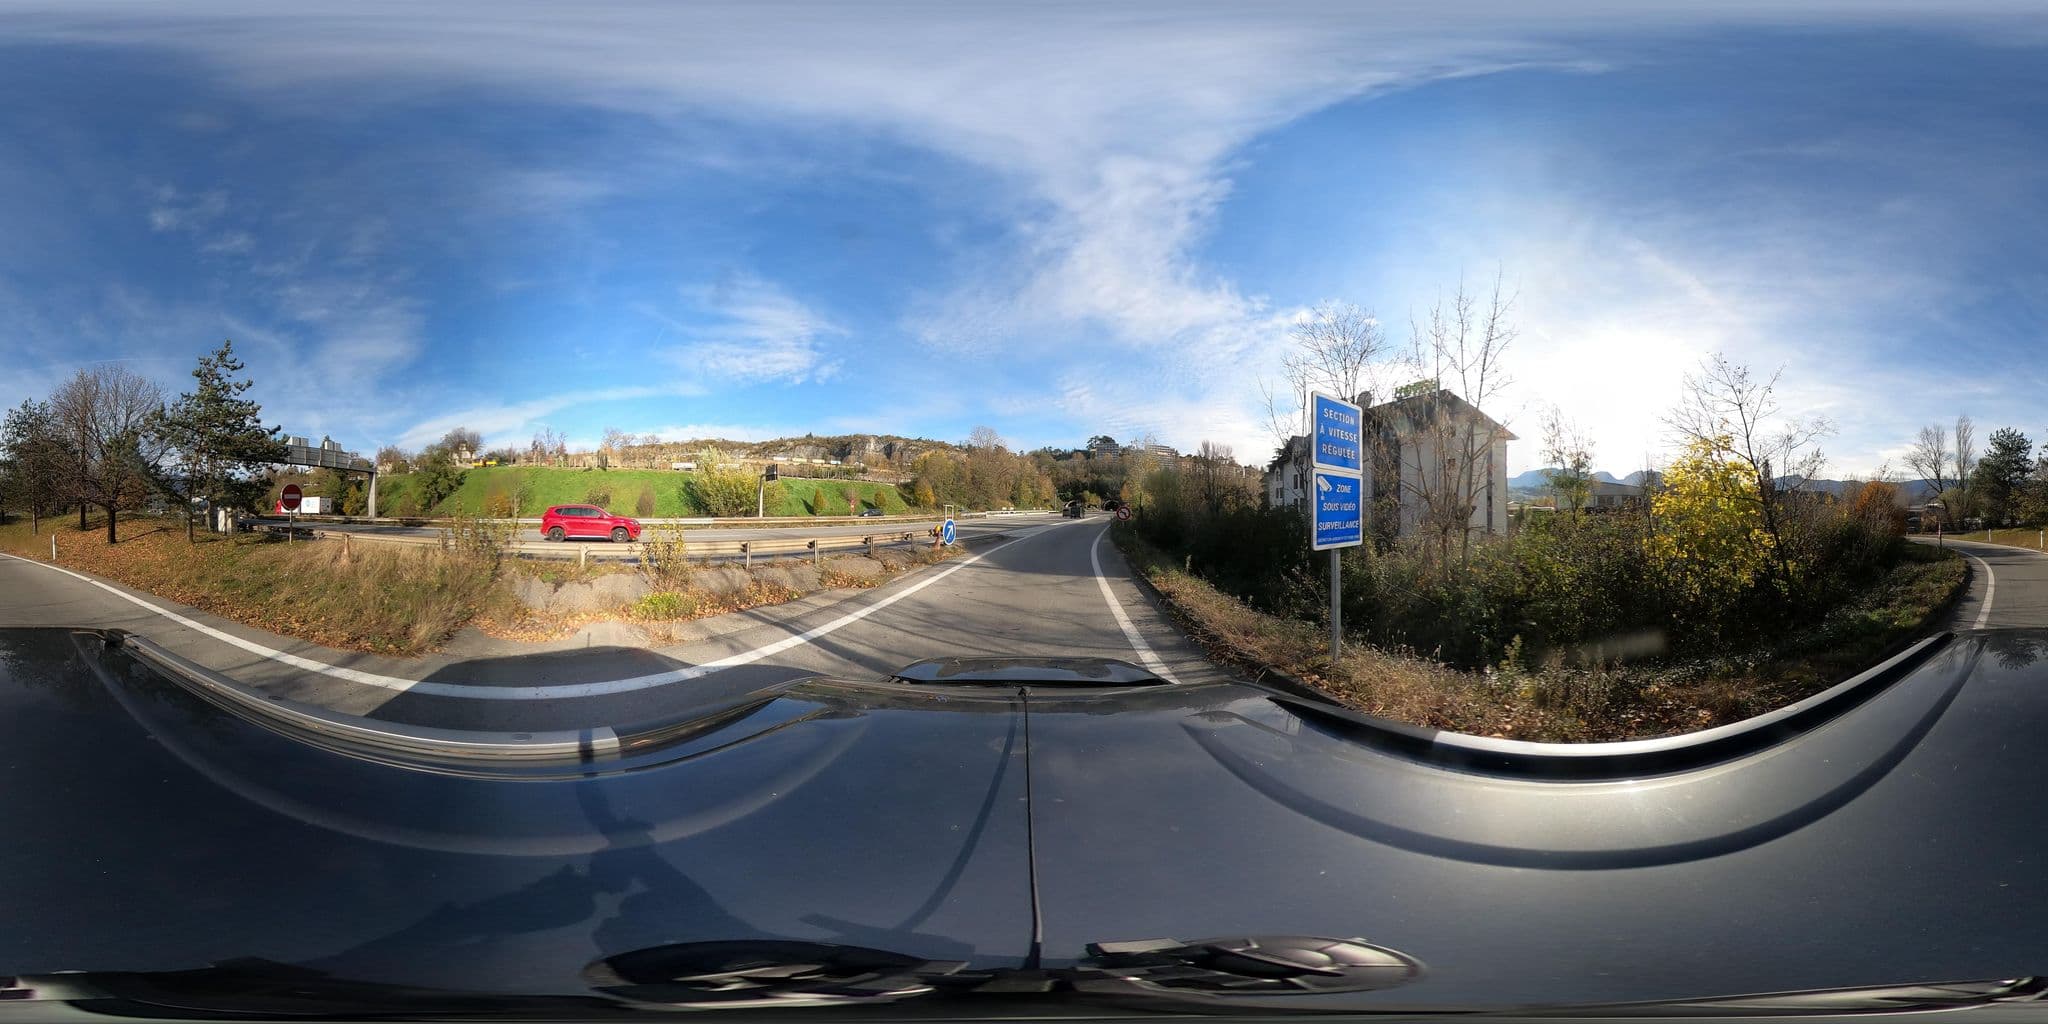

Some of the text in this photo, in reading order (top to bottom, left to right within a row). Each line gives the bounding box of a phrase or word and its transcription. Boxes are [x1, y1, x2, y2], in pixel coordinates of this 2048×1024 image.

[1323, 408, 1355, 425] SECTION
[1319, 424, 1358, 443] À VITESSE
[1322, 443, 1356, 459] RÉGULÉE
[1336, 483, 1352, 494] ZONE
[1322, 501, 1356, 512] SOUS VIDÉO
[1318, 519, 1360, 531] SURVEILLANCE
